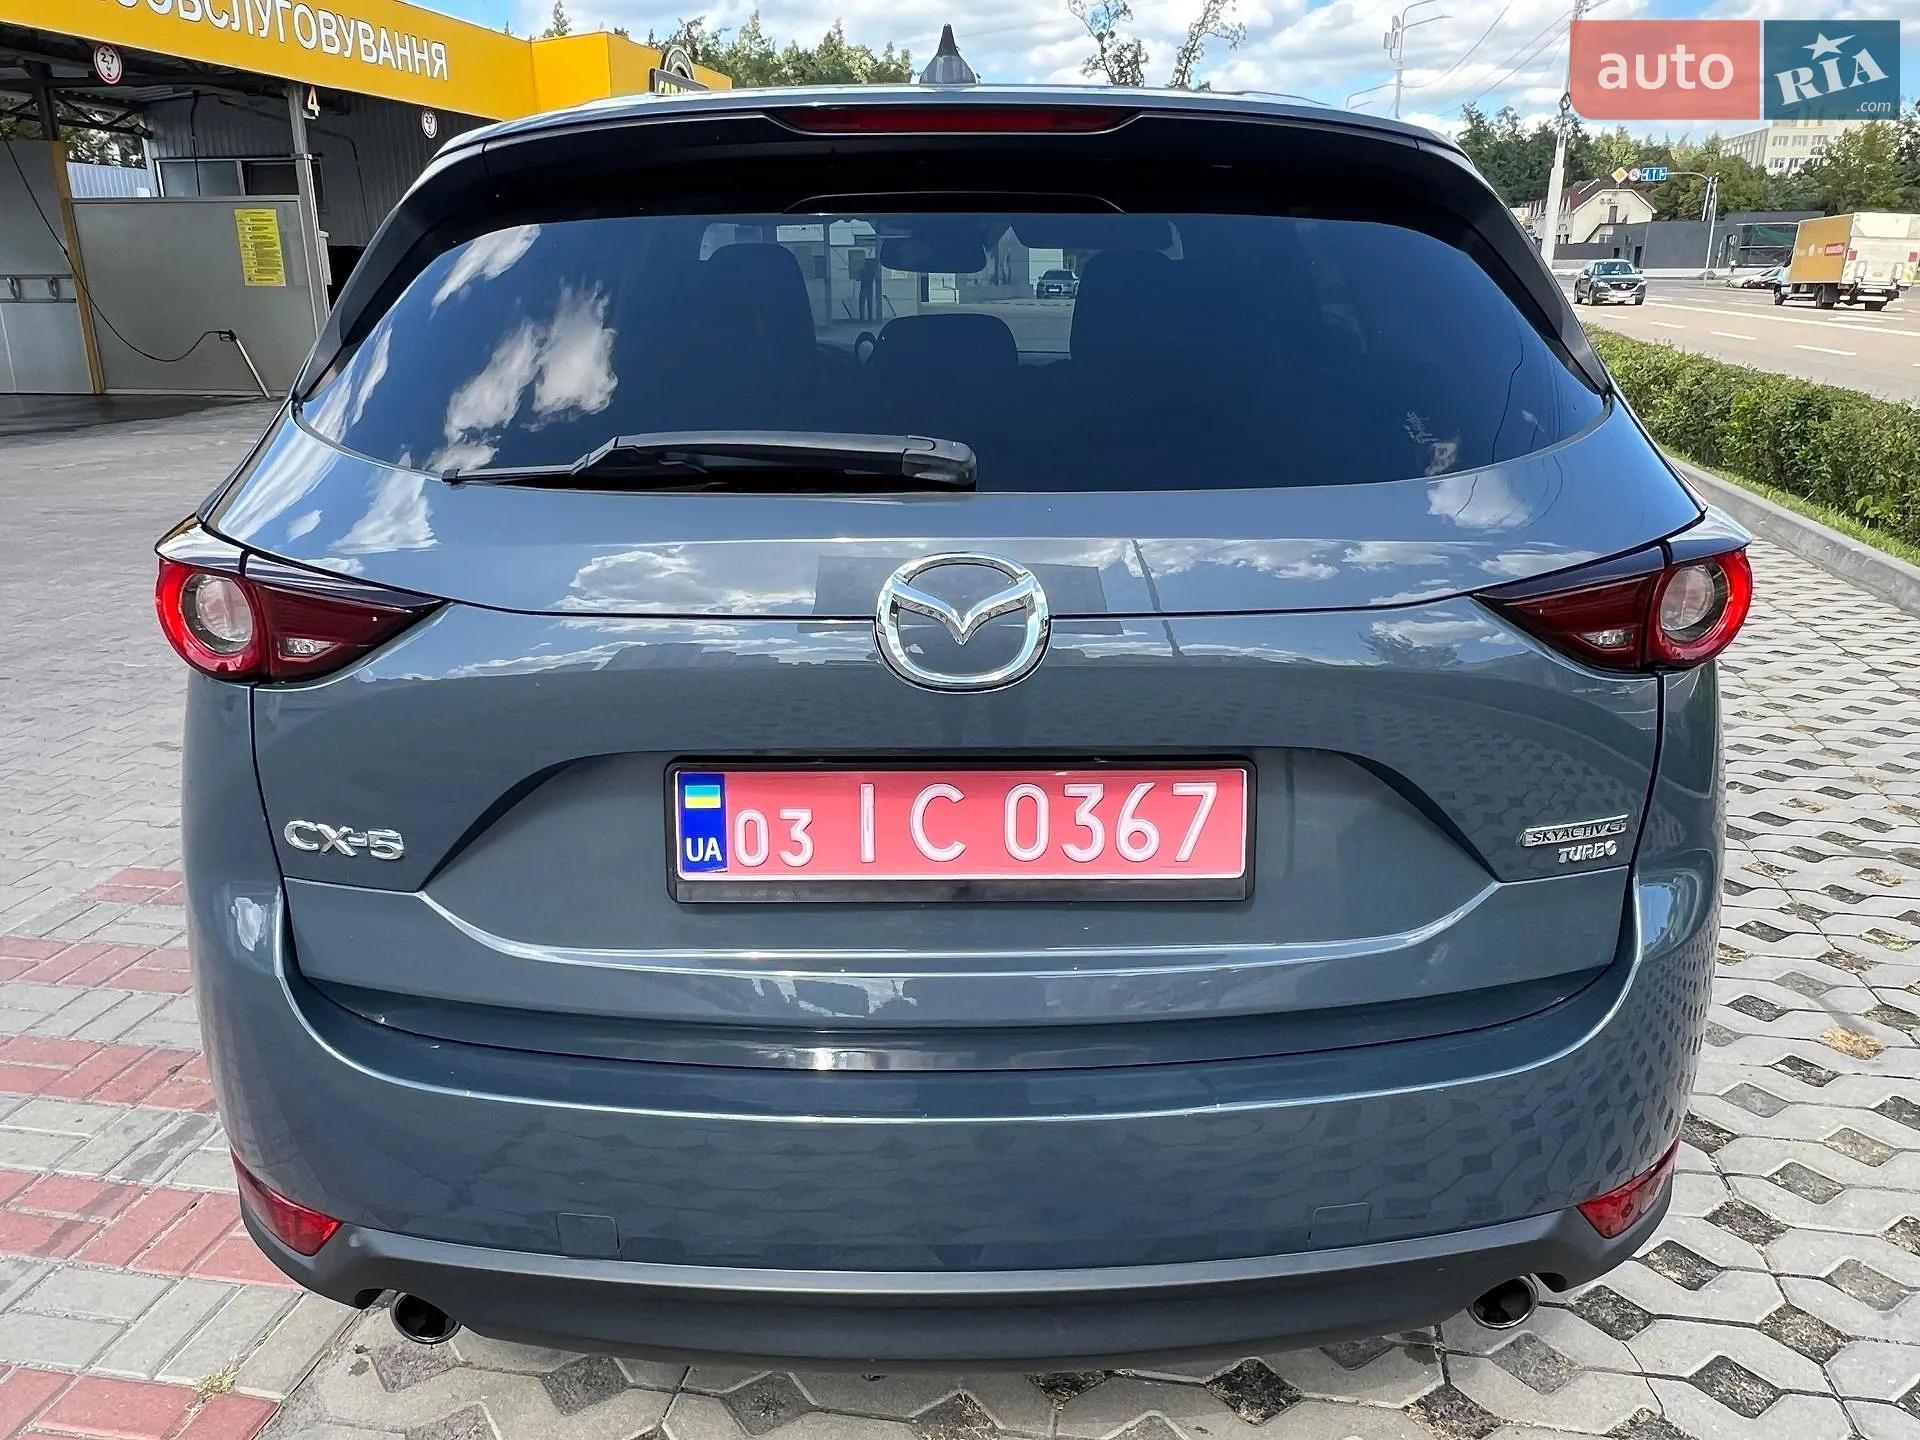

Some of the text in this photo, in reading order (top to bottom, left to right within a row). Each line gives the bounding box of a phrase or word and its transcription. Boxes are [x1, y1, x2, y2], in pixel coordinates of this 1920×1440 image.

[307, 86, 320, 117] 4
[284, 820, 404, 860] CX-5
[734, 808, 814, 867] 03
[1003, 782, 1217, 863] 0367
[686, 837, 723, 862] UA
[1558, 840, 1617, 863] TURBO
